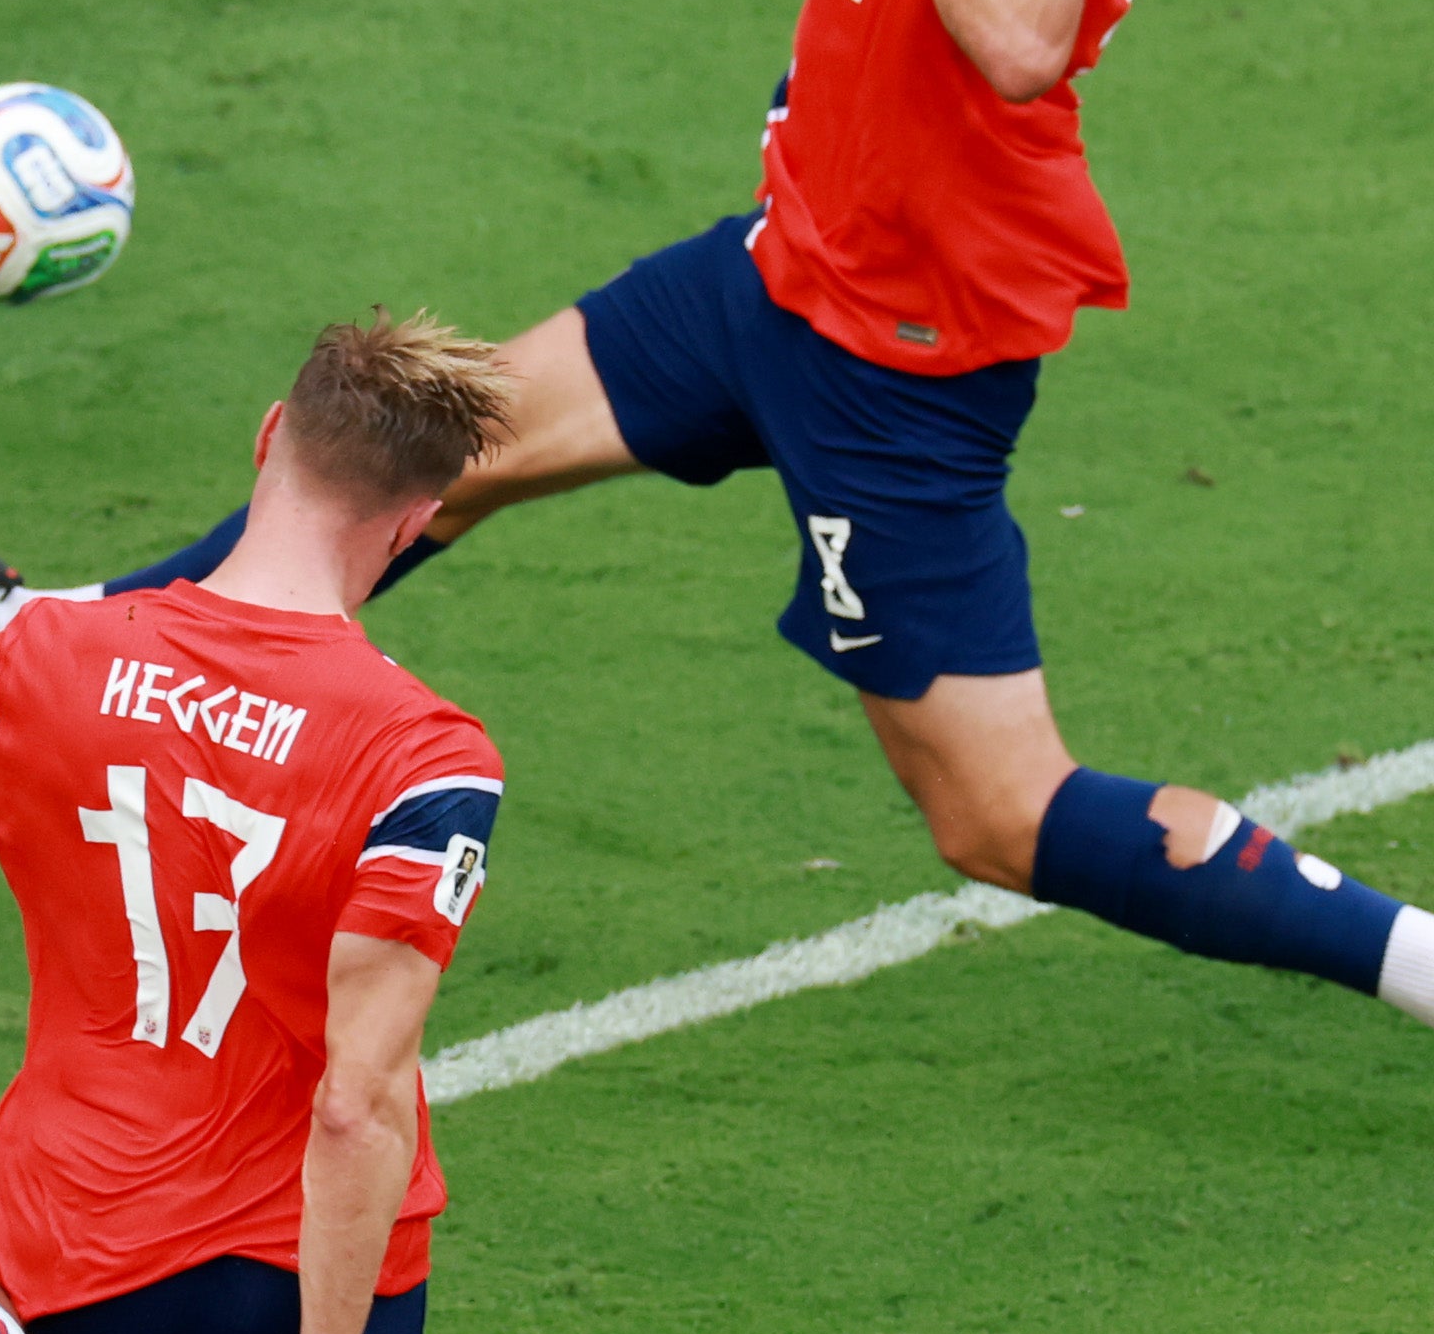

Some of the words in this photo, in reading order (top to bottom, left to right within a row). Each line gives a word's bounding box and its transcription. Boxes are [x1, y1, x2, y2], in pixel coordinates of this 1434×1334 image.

[808, 514, 865, 620] 8
[99, 657, 308, 765] HEGGEM
[77, 764, 287, 1059] 17
